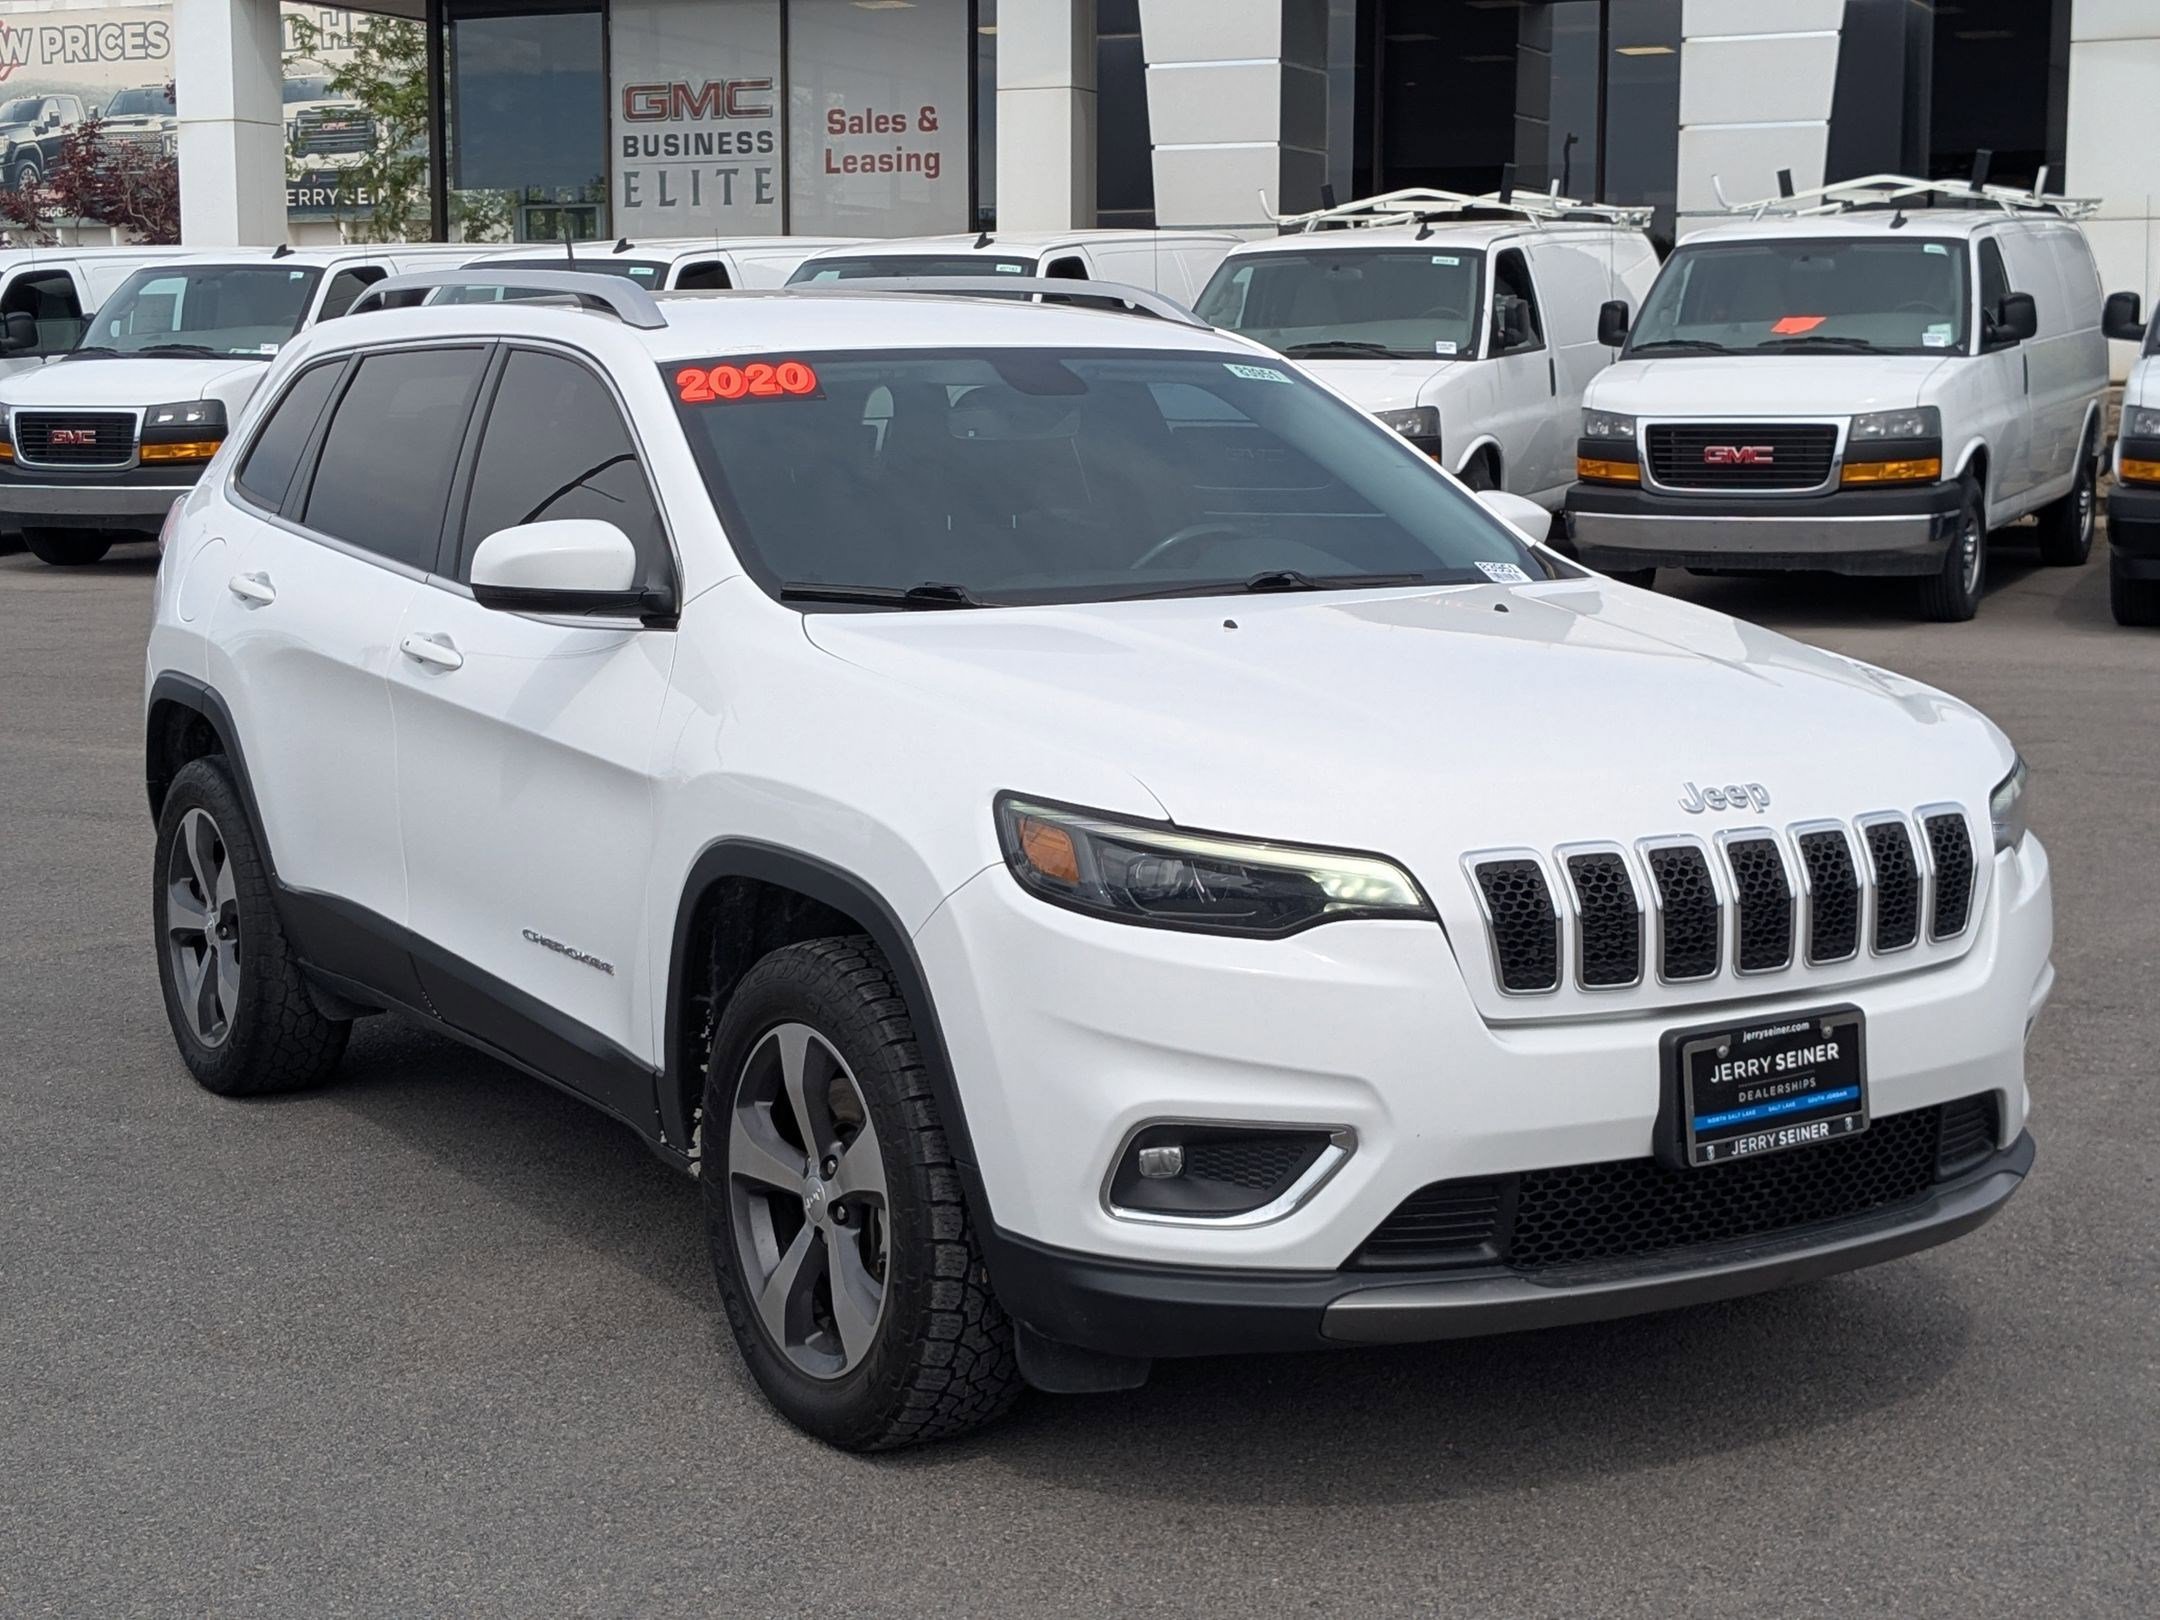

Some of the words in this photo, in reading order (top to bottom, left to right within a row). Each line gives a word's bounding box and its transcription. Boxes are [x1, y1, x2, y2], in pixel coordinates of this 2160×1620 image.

[0, 28, 33, 66] W
[40, 21, 170, 64] PRICES
[622, 77, 773, 123] GMC
[827, 108, 907, 134] Sales
[917, 105, 939, 132] &
[623, 130, 774, 157] BUSINESS
[825, 146, 940, 179] Leasing
[285, 187, 339, 206] ERRY
[623, 167, 775, 207] ELITE
[676, 361, 817, 402] 2020
[52, 429, 97, 445] GMC
[1703, 446, 1775, 464] GMC
[1678, 782, 1770, 814] Jeep
[1742, 1022, 1810, 1043] jerryseiner.com
[1710, 1055, 1772, 1083] JERRY
[1775, 1042, 1840, 1071] SEINER
[1738, 1076, 1817, 1103] DEALERSHIPS
[1731, 1133, 1776, 1155] JERRY
[1778, 1122, 1829, 1145] SEINER
